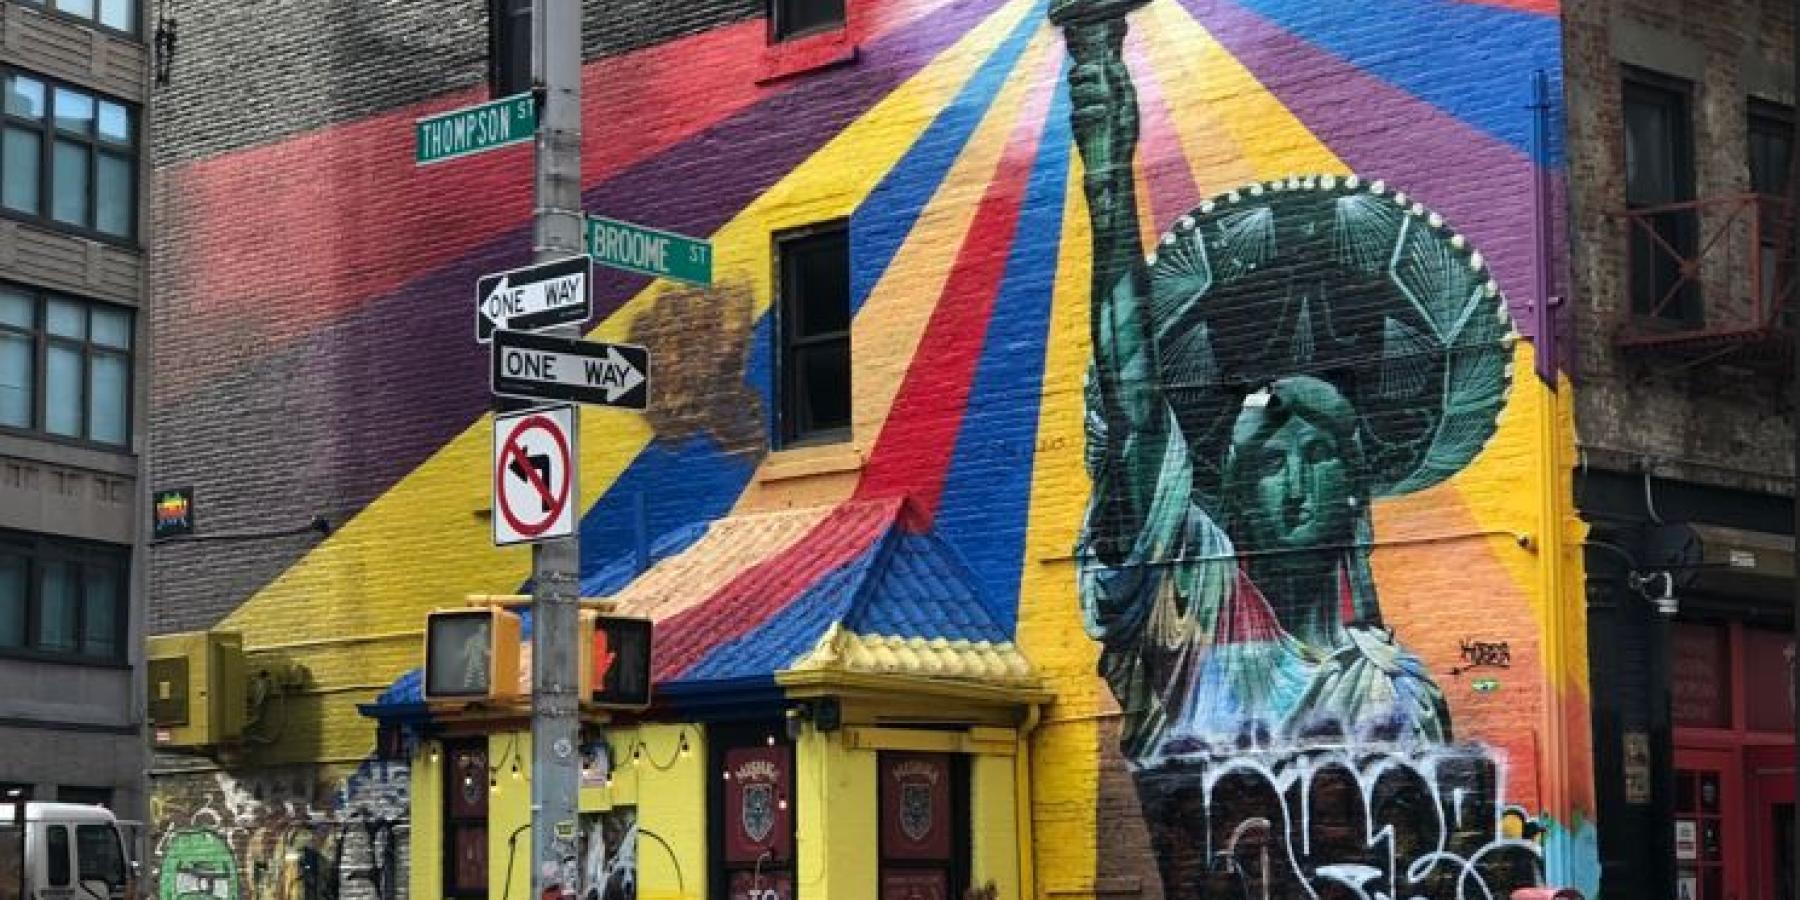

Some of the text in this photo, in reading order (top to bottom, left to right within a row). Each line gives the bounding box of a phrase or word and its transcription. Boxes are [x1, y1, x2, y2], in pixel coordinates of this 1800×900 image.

[422, 100, 534, 158] THOMPSON ST
[594, 223, 707, 272] BROOME ST
[489, 276, 579, 318] ONE WAY
[507, 351, 630, 388] ONE WAY
